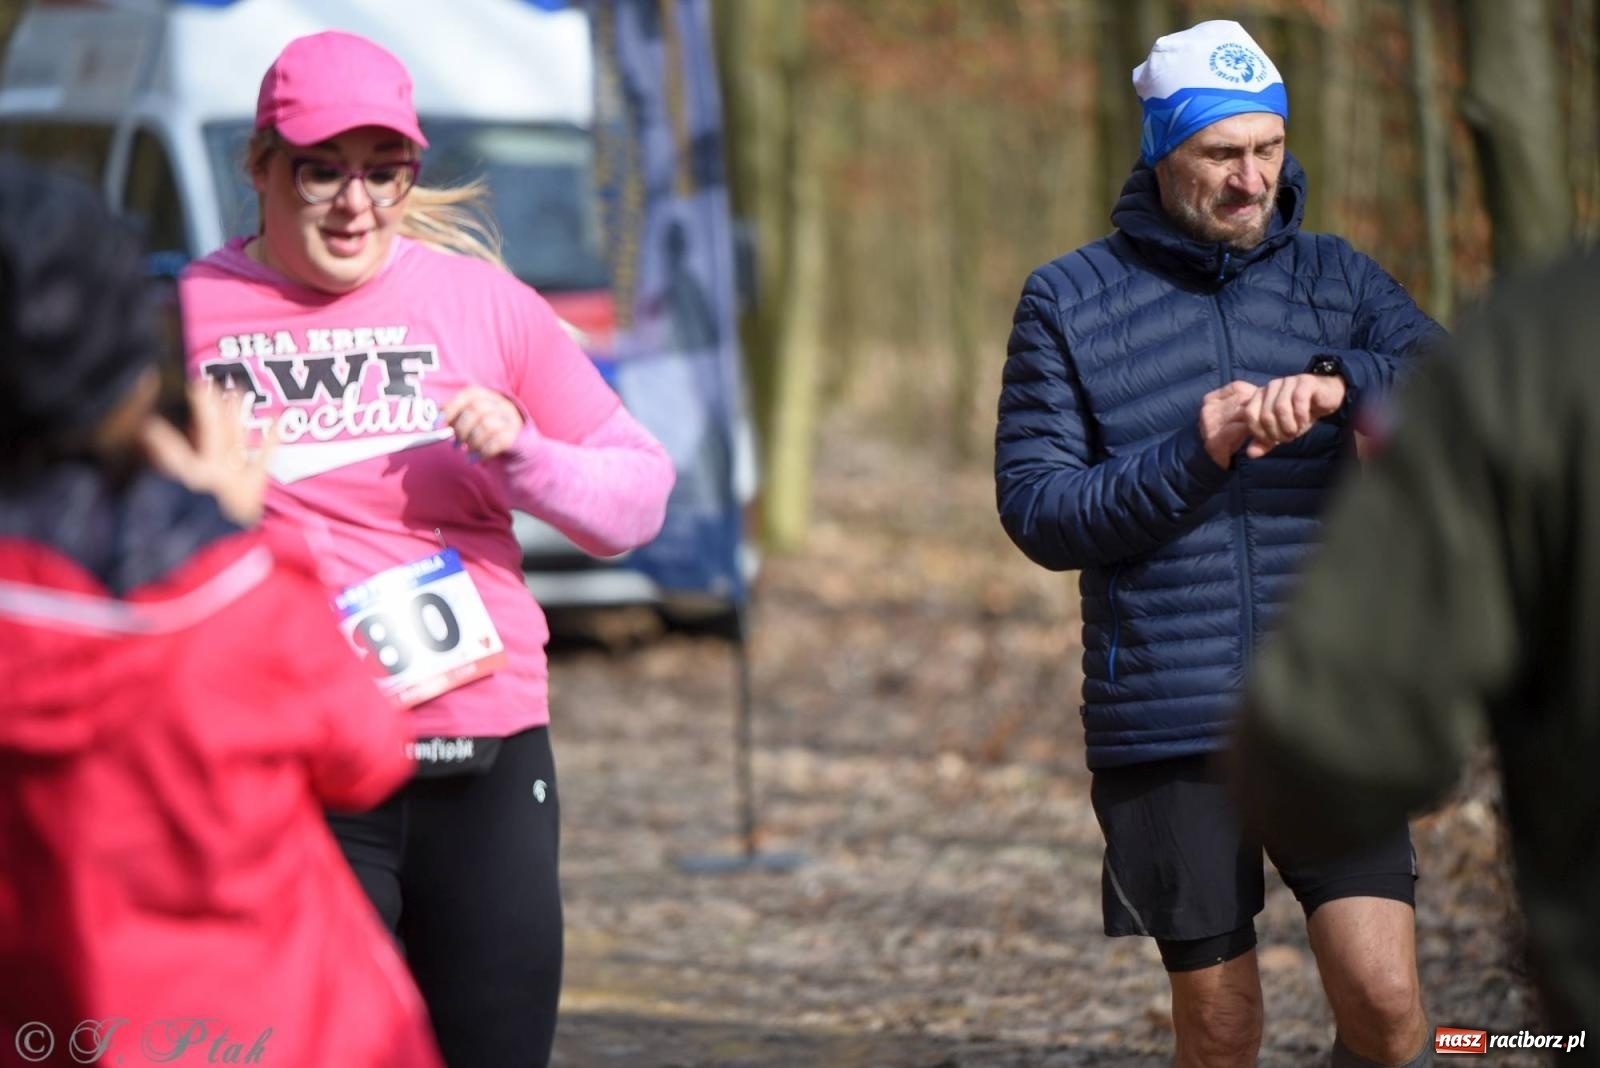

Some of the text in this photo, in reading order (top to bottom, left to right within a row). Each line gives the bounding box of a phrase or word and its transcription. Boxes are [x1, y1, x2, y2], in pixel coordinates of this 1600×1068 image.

[218, 326, 407, 358] SIŁA KREW
[201, 346, 438, 410] AWF
[353, 592, 461, 677] 80
